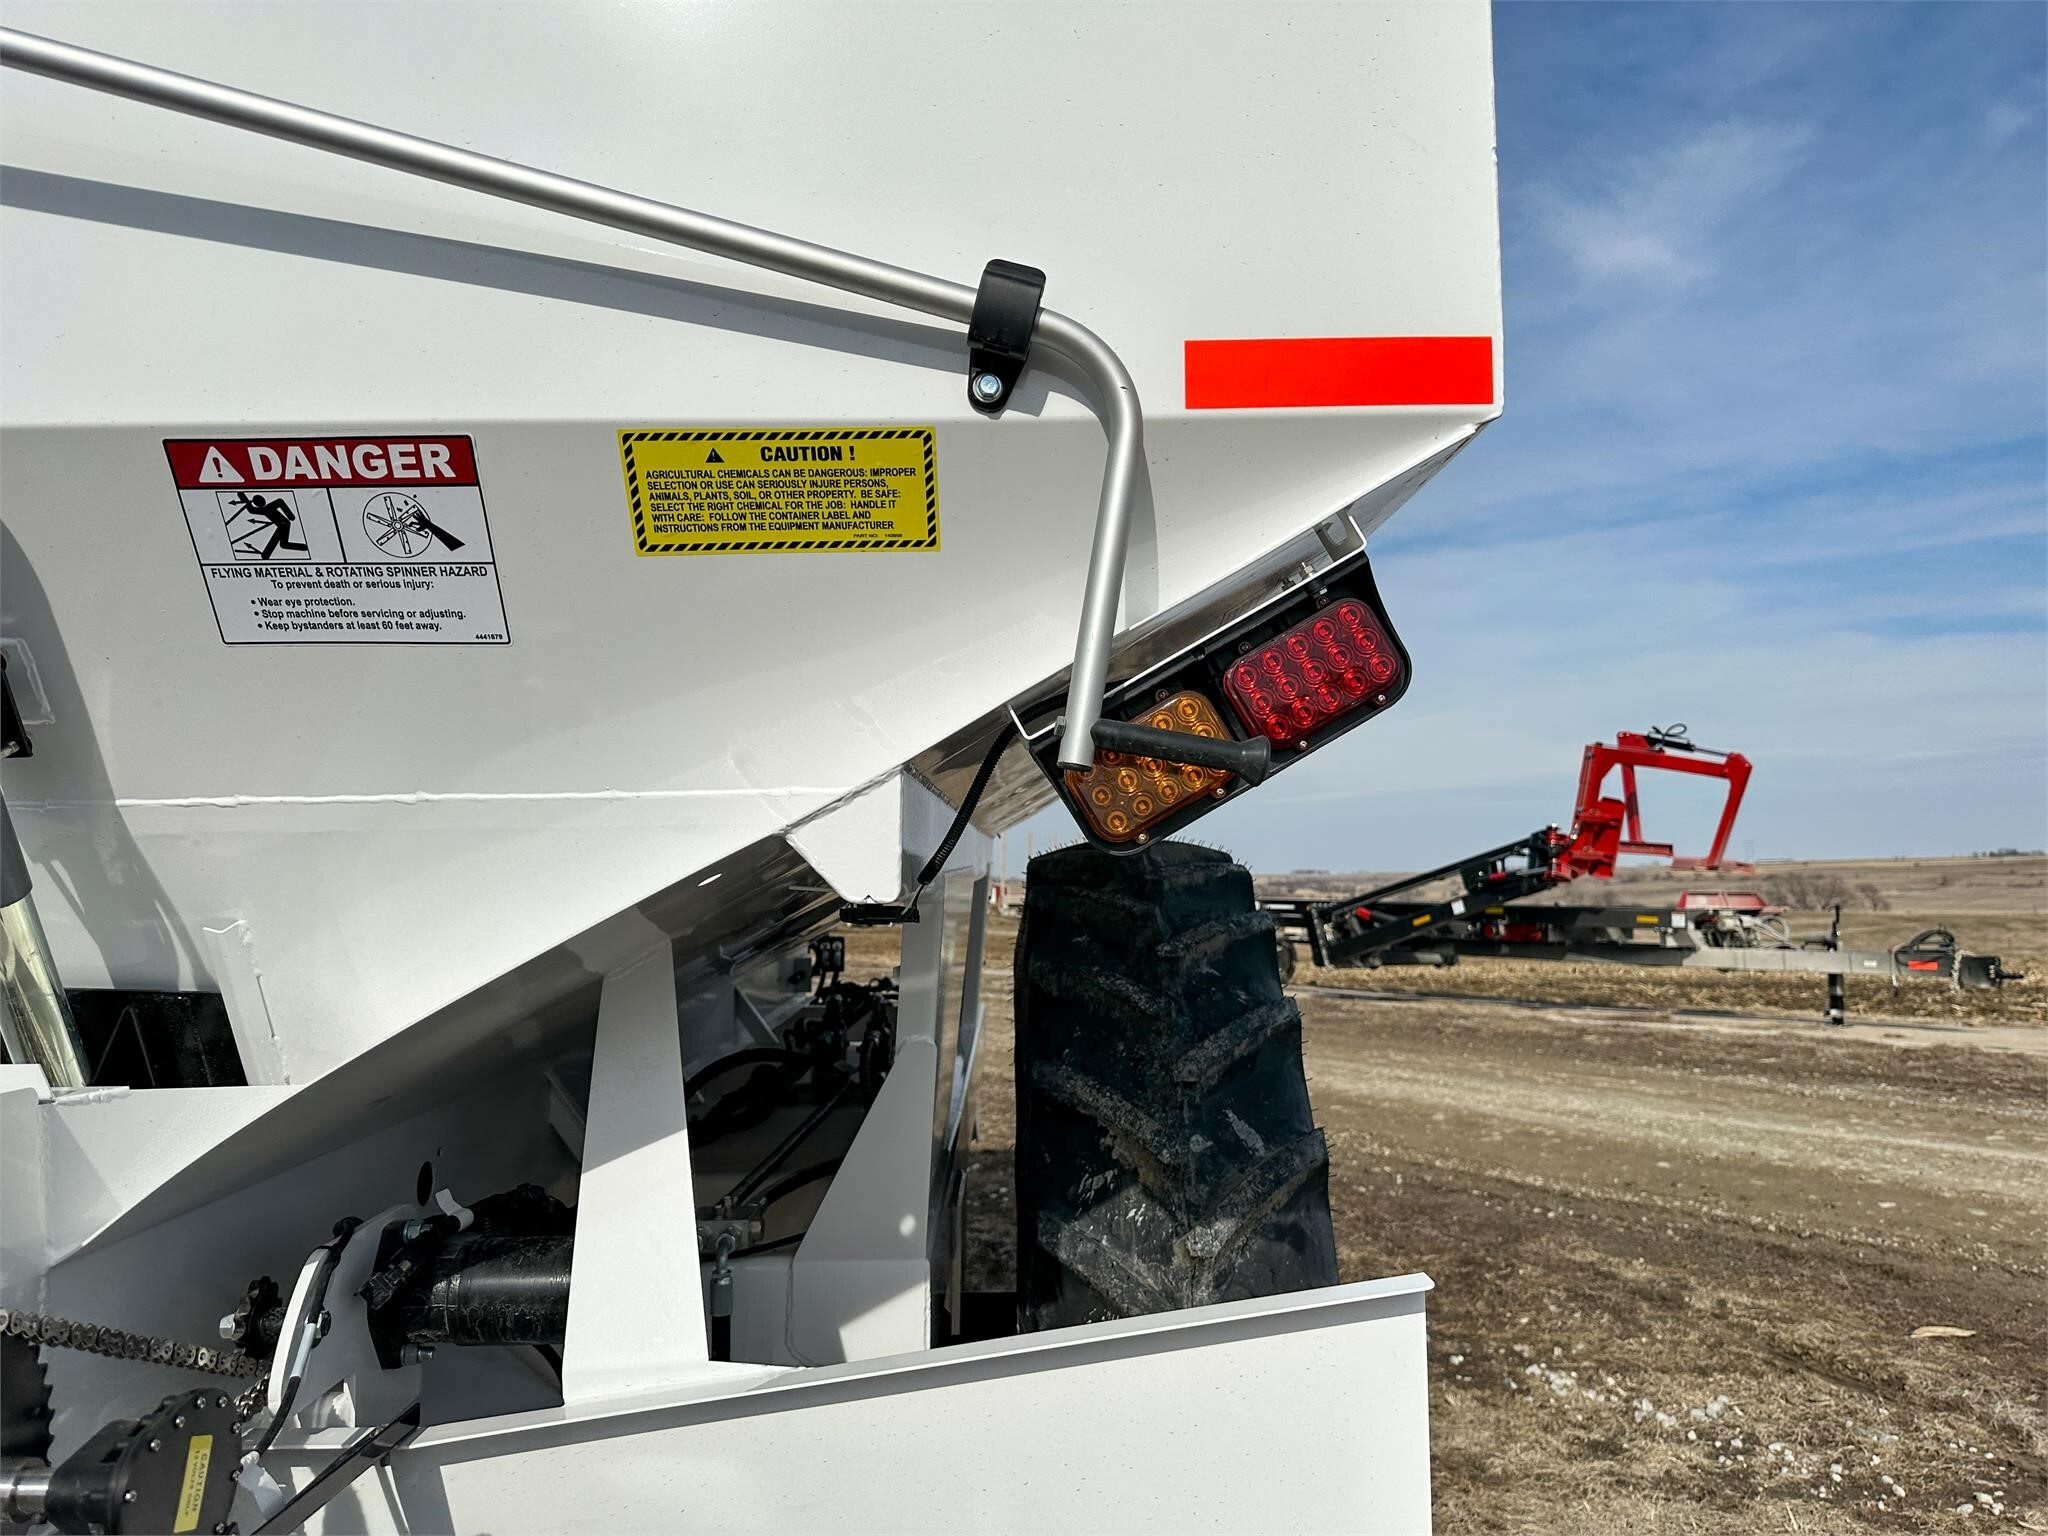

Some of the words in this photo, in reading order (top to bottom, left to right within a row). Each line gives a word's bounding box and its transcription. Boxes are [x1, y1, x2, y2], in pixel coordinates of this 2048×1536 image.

[760, 446, 843, 462] CAUTION
[849, 446, 855, 460] !
[248, 444, 456, 480] DANGER
[646, 470, 715, 479] AGRICULTURAL
[718, 469, 770, 478] CHEMICALS
[772, 469, 792, 478] CAN
[794, 469, 806, 477] BE
[808, 468, 868, 477] DANGEROUS:
[870, 467, 916, 476] IMPROPER
[647, 481, 699, 490] SELECTION
[701, 481, 714, 489] OR
[716, 480, 734, 489] USE
[736, 480, 756, 489] CAN
[758, 479, 808, 488] SERIOUSLY
[810, 479, 841, 488] INJURE
[843, 478, 888, 489] PERSONS,
[649, 491, 692, 502] ANIMALS,
[694, 491, 731, 501] PLANTS,
[733, 491, 756, 501] SOIL,
[758, 490, 772, 499] OR
[774, 490, 805, 499] OTHER
[807, 490, 856, 499] PROPERTY.
[861, 489, 873, 498] BE
[876, 489, 901, 498] SAFE:
[650, 502, 685, 512] SELECT
[687, 502, 706, 511] THE
[707, 502, 735, 510] RIGHT
[737, 501, 783, 510] CHEMICAL
[785, 501, 804, 510] FOR
[806, 501, 823, 510] THE
[825, 500, 846, 509] JOB:
[850, 500, 885, 509] HANDLE
[887, 500, 896, 508] IT
[652, 512, 675, 522] WITH
[677, 512, 704, 522] CARE:
[709, 512, 748, 521] FOLLOW
[749, 512, 767, 520] THE
[769, 511, 820, 520] CONTAINER
[822, 511, 850, 520] LABEL
[852, 511, 871, 519] AND
[654, 522, 719, 532] INSTRUCTIONS
[721, 522, 748, 531] FROM
[749, 522, 766, 531] THE
[768, 521, 820, 530] EQUIPMENT
[822, 521, 894, 530] MANUFACTURER
[211, 568, 252, 578] FLYING
[255, 568, 312, 578] MATERIAL
[315, 568, 323, 578] &
[326, 567, 383, 578] ROTATING
[386, 567, 437, 577] SPINNER
[440, 567, 488, 577] HAZARD
[272, 580, 284, 589] To
[286, 580, 321, 590] prevent
[324, 580, 350, 589] death
[366, 580, 400, 588] serious
[403, 579, 434, 590] injury:
[258, 598, 282, 606] Wear
[285, 599, 301, 608] eye
[304, 598, 356, 608] protection.
[262, 609, 283, 620] Stop
[286, 609, 326, 618] machine
[328, 609, 358, 618] before
[361, 609, 404, 620] servicing
[419, 609, 466, 620] adjusting.
[265, 621, 289, 632] Keep
[291, 621, 343, 632] bystanders
[358, 621, 379, 630] least
[395, 621, 414, 629] feet
[416, 623, 442, 631] away.
[193, 1453, 208, 1512] CAUTION
